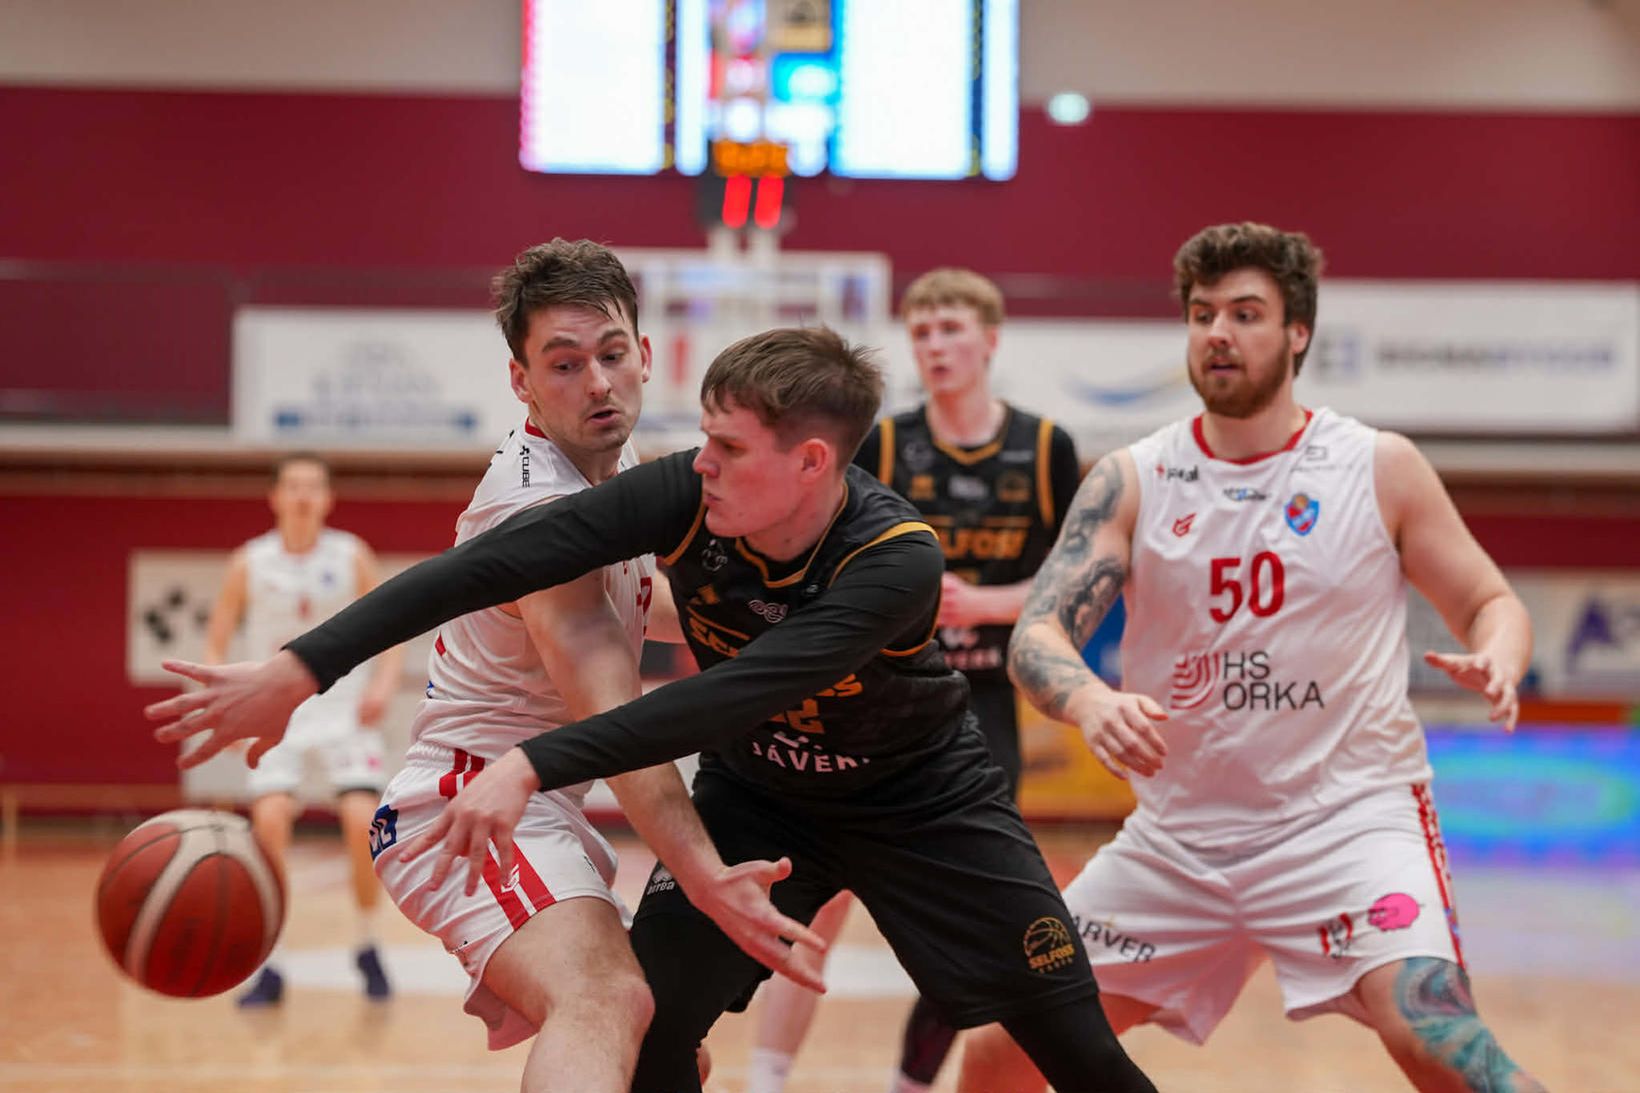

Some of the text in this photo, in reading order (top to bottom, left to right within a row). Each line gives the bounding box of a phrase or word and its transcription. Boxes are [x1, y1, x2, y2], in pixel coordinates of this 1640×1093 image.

[1209, 551, 1285, 624] 50
[1222, 651, 1271, 680] HS
[1222, 681, 1325, 711] ORKA
